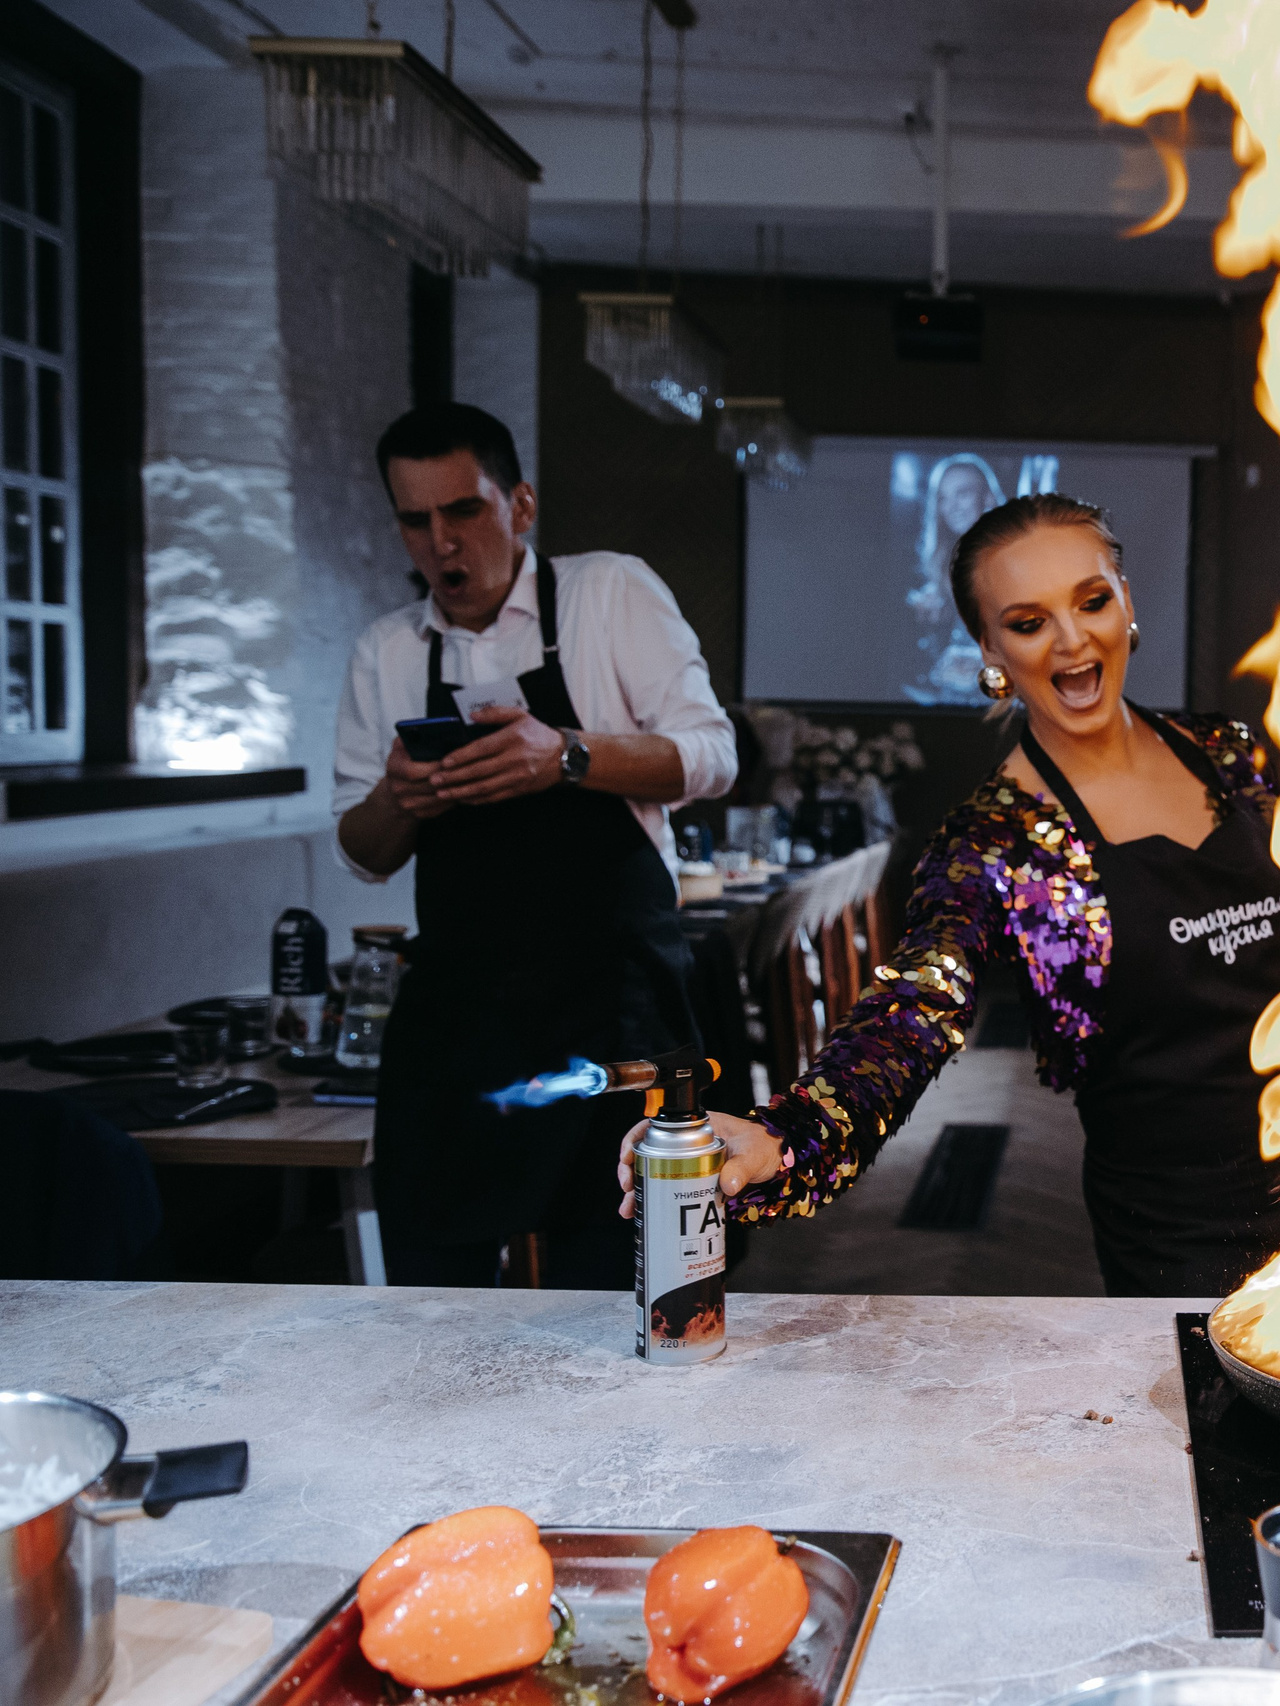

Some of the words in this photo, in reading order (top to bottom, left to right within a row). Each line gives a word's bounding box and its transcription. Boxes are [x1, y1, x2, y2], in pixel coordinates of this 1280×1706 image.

[1208, 919, 1274, 965] кухня
[673, 1186, 719, 1200] УНИВЕРСА
[660, 1339, 679, 1348] 220
